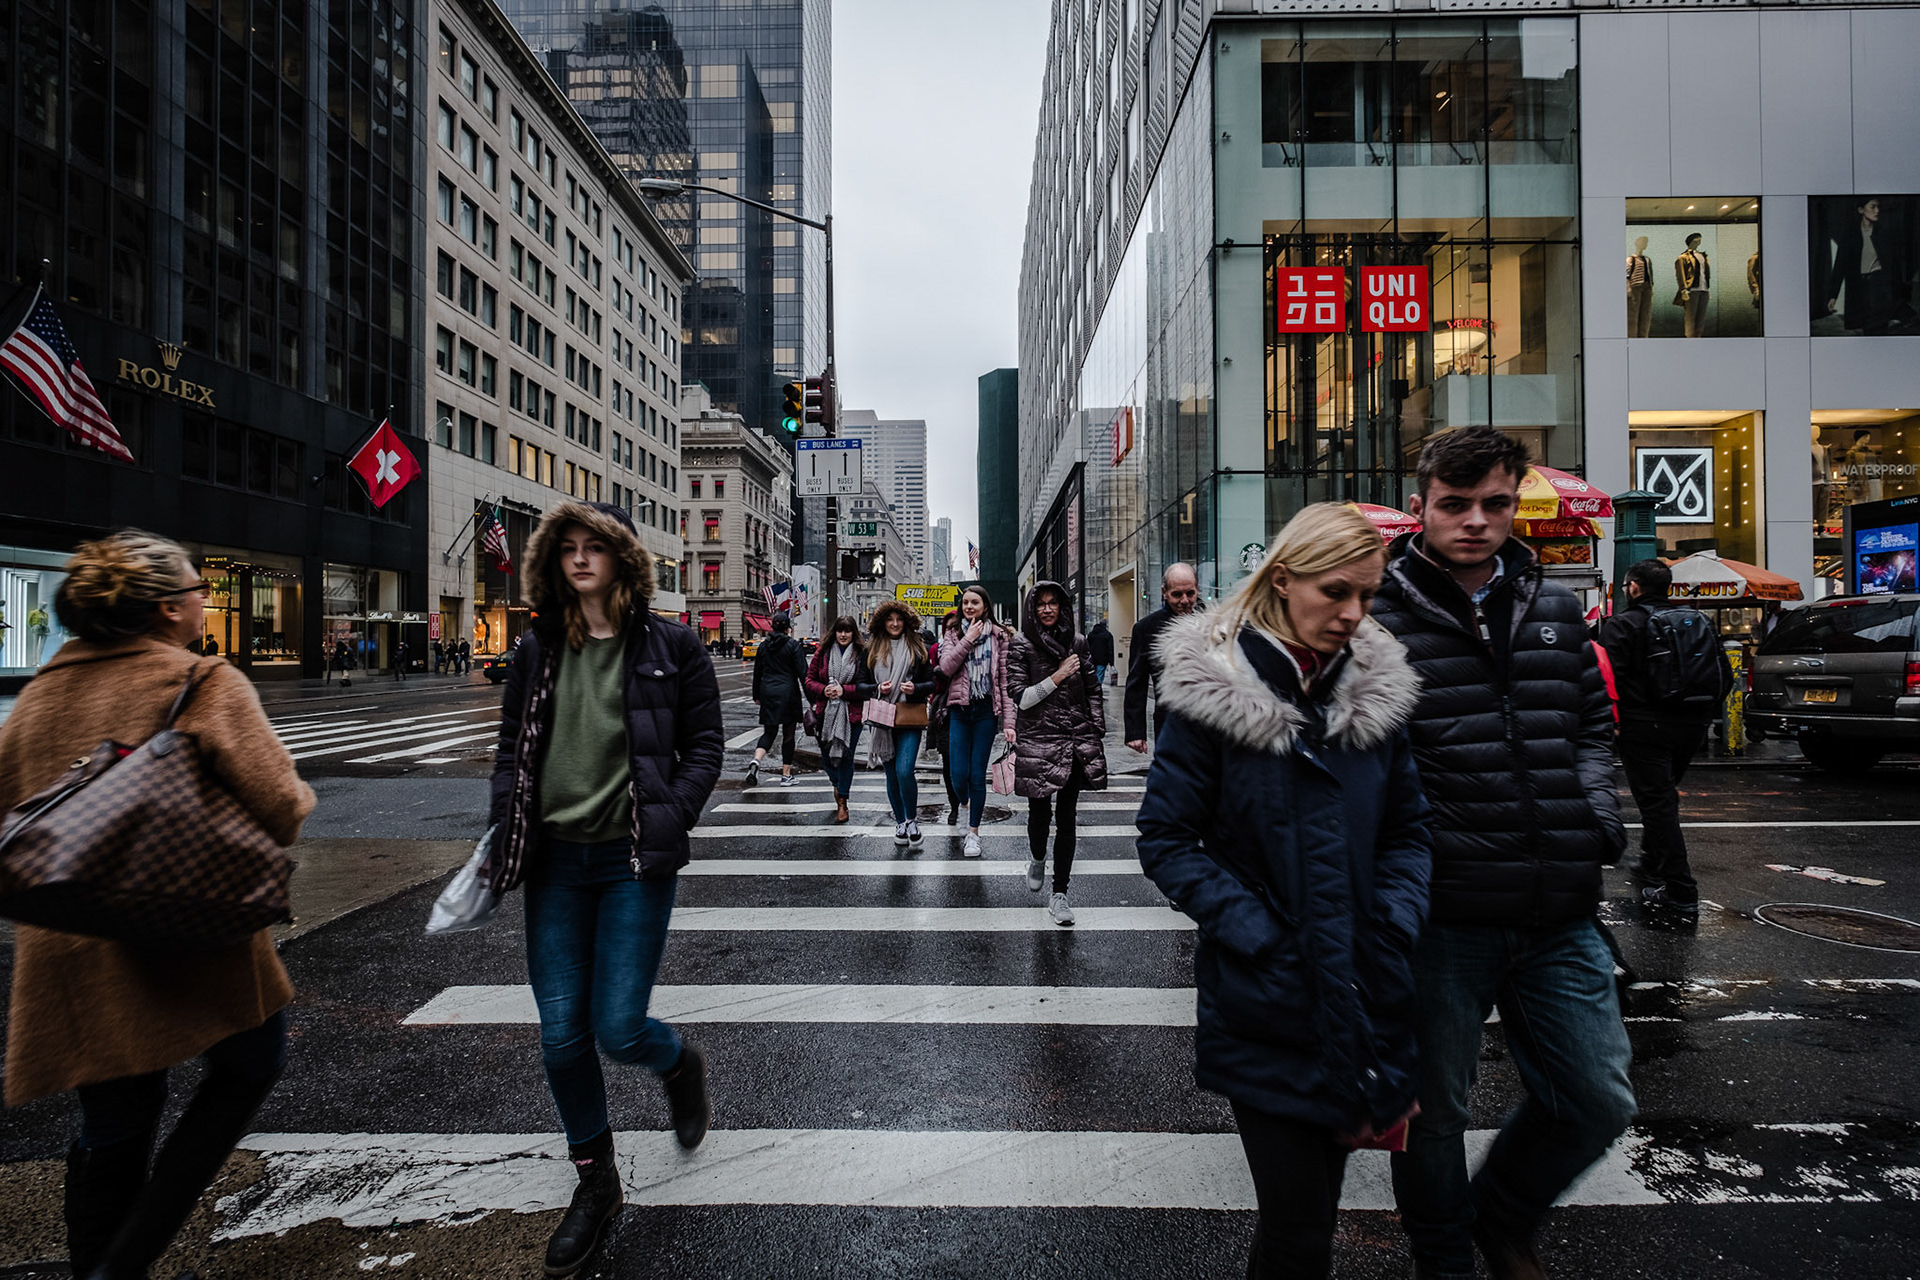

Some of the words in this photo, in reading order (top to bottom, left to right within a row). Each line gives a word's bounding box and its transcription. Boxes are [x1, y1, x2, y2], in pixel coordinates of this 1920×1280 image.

[1368, 274, 1416, 297] UNI
[1369, 301, 1420, 328] QLO
[118, 358, 216, 408] ROLEX
[812, 441, 825, 449] BUS
[826, 440, 847, 448] LANES
[1841, 464, 1918, 476] WATERPROOF
[806, 478, 823, 486] BUSES
[837, 477, 854, 485] BUSES
[1532, 505, 1553, 513] Dogs
[848, 523, 856, 534] W
[858, 523, 867, 534] 53
[903, 587, 948, 599] SUBWAY
